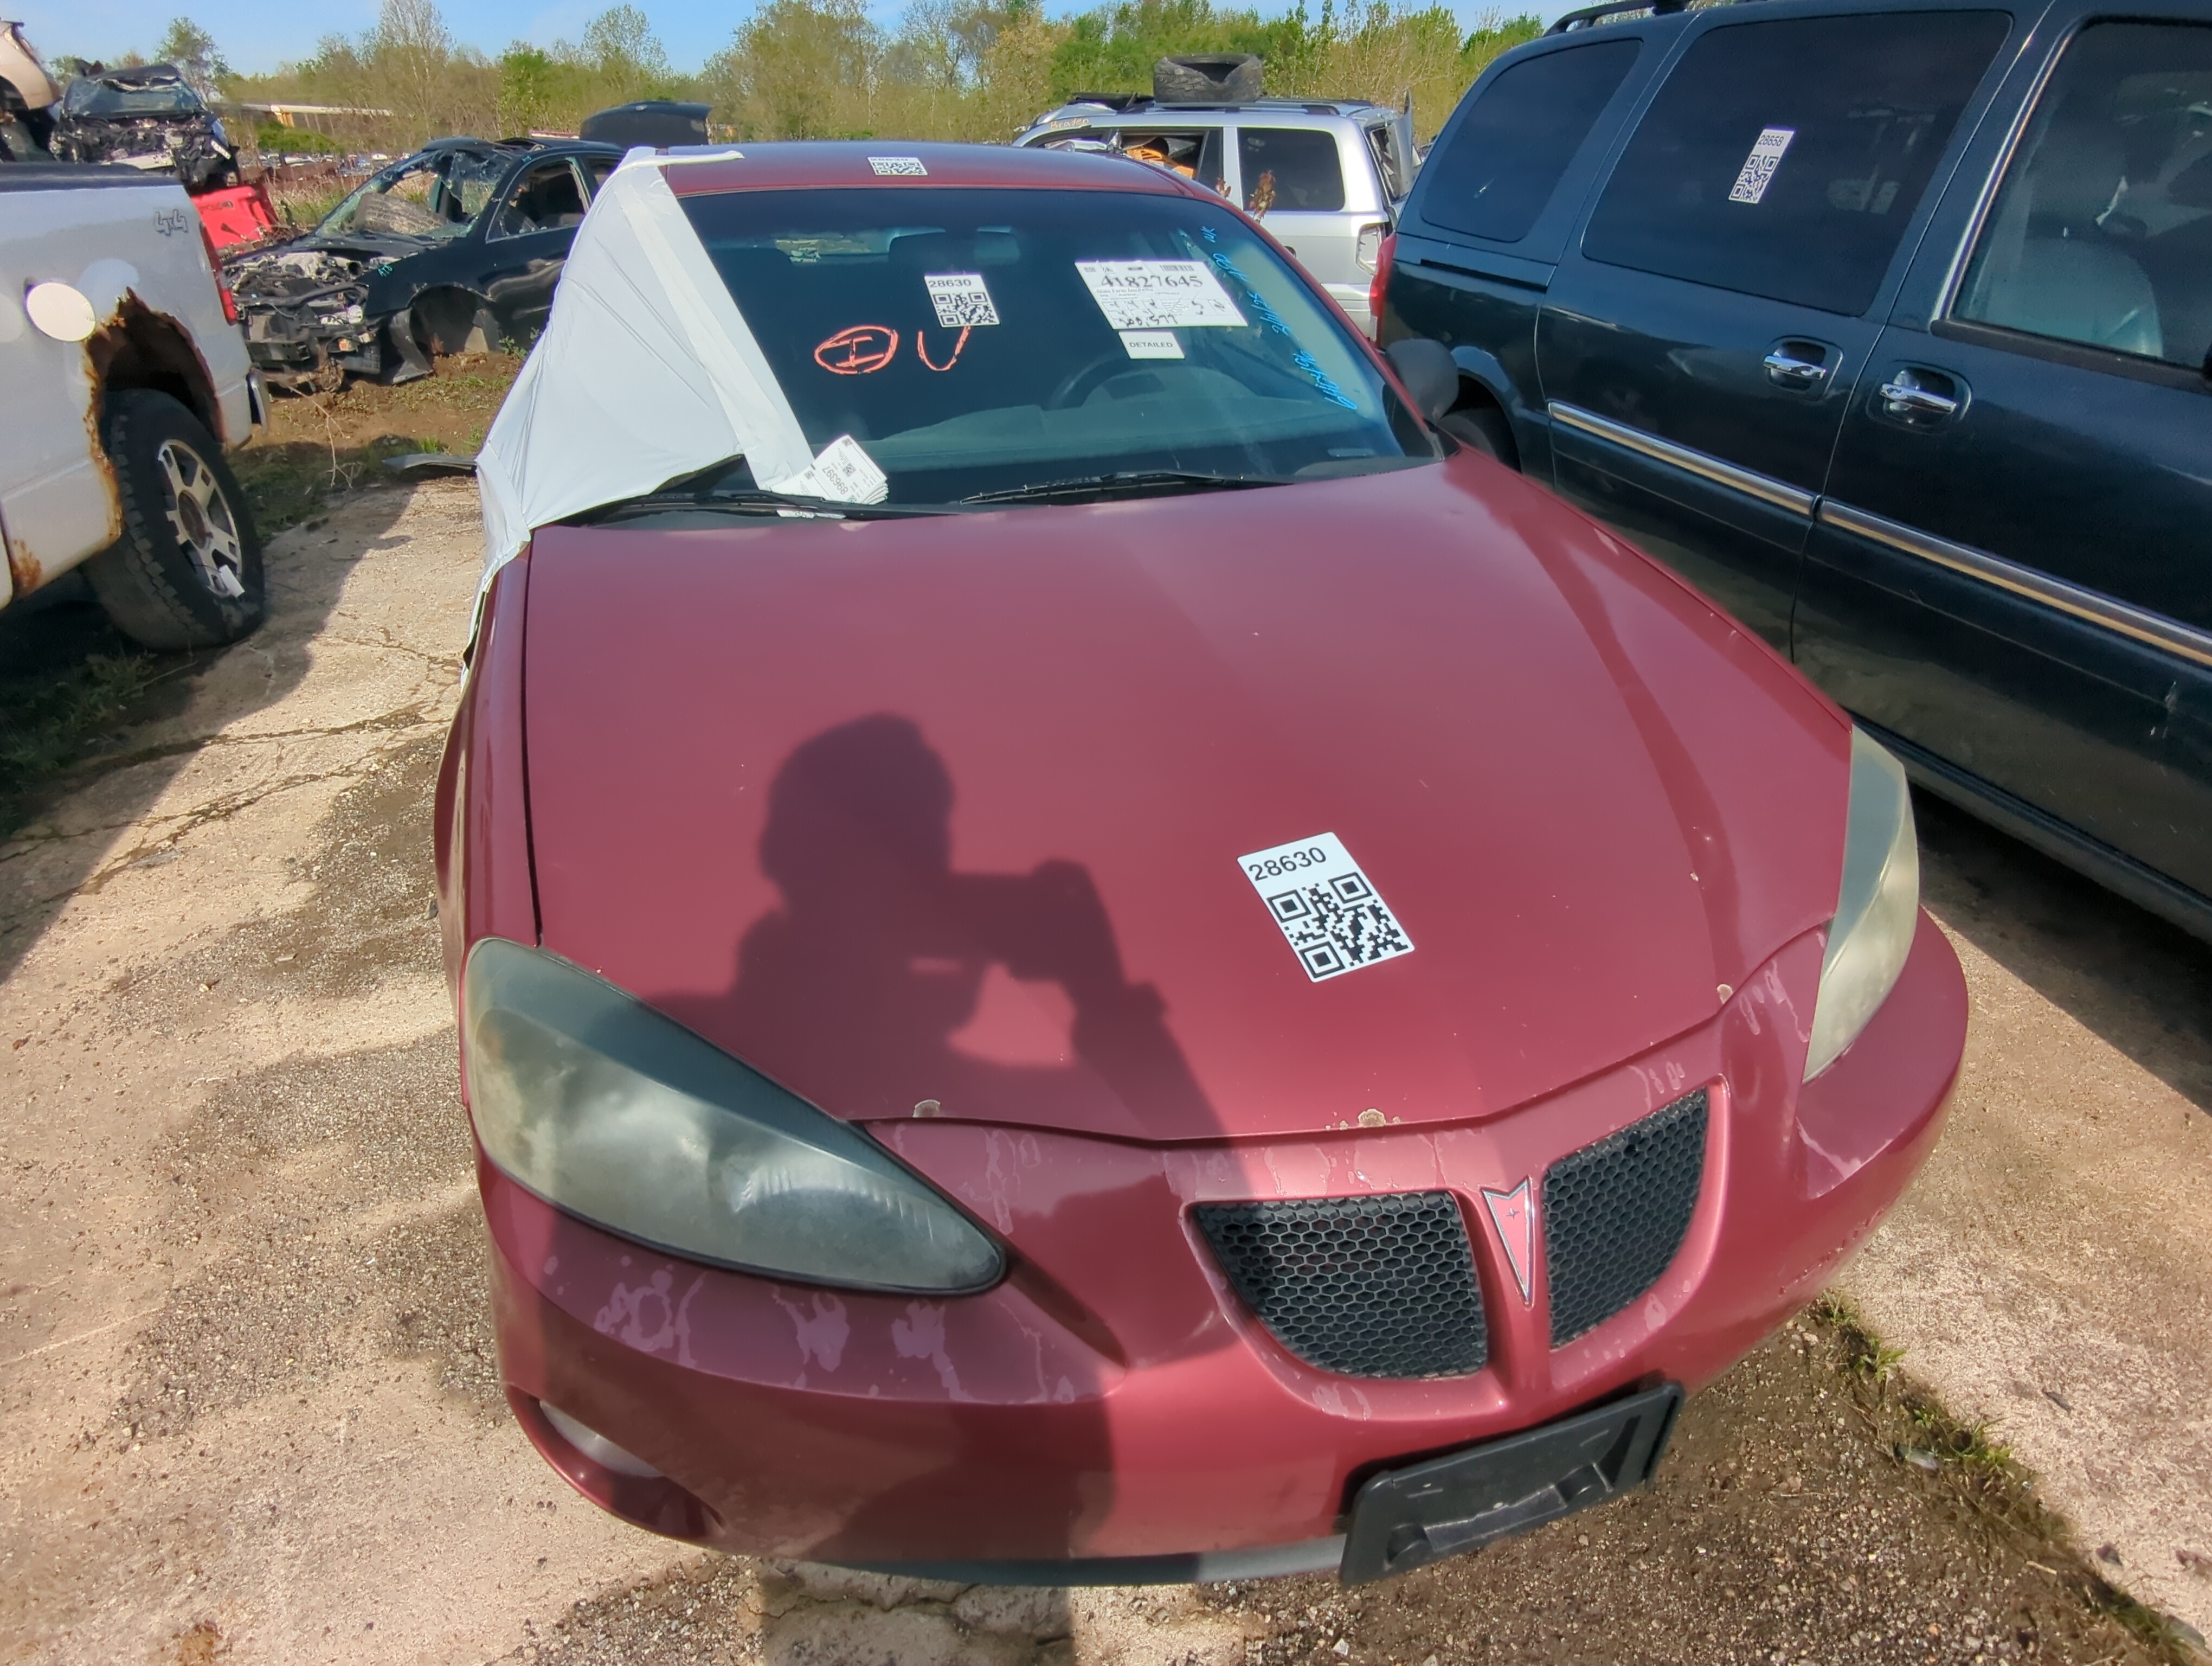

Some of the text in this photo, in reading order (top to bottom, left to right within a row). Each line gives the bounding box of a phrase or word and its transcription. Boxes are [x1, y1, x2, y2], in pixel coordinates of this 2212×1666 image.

[1050, 118, 1089, 129] Braden
[1758, 135, 1784, 146] 28658
[928, 279, 972, 289] 28630
[1101, 274, 1203, 288] 41827645
[822, 466, 848, 495] 896397
[1248, 847, 1327, 881] 28630
